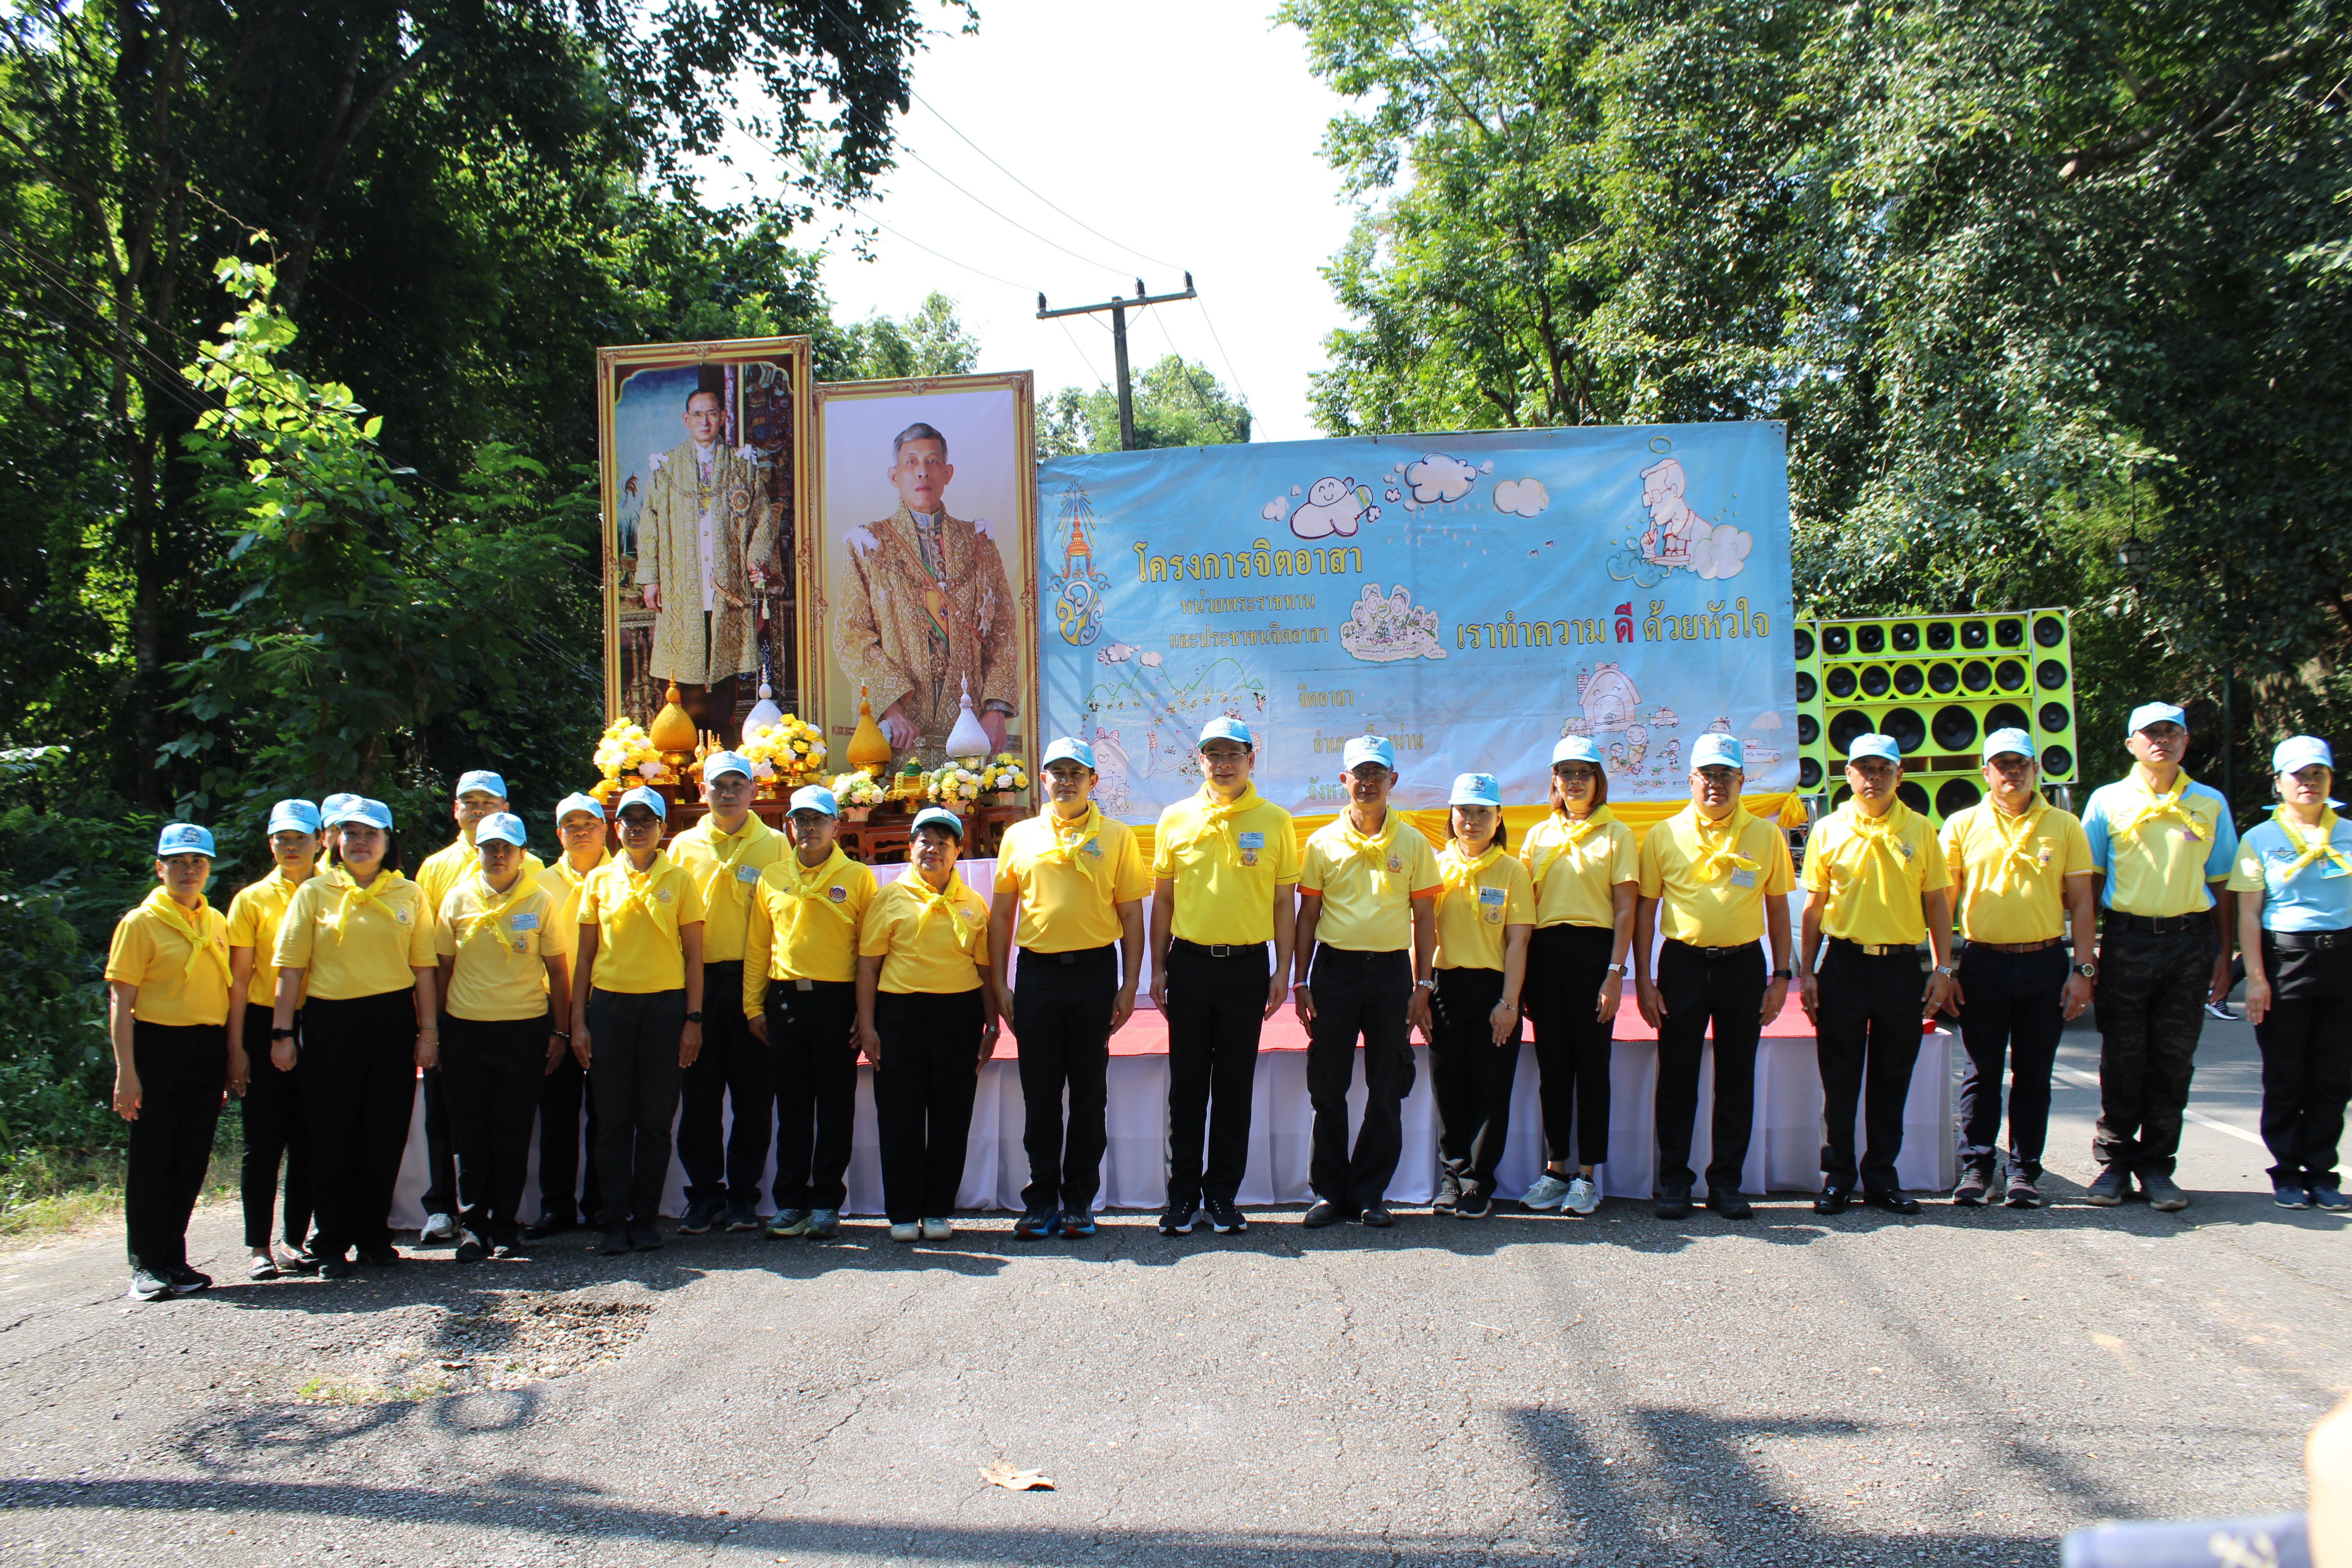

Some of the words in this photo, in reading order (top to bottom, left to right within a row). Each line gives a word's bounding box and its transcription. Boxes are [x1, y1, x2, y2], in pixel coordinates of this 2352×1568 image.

[1132, 537, 1363, 583] โครงการจิตอาสา
[1180, 590, 1316, 615] หน่วยพระราชทาน
[1169, 622, 1329, 649] และประชาชนจิตอาสา
[1457, 610, 1606, 649] เราทำความ
[1614, 602, 1634, 643] ดี
[1642, 596, 1770, 642] ด้วยหัวใจ
[1298, 683, 1354, 708] จิตอาสา
